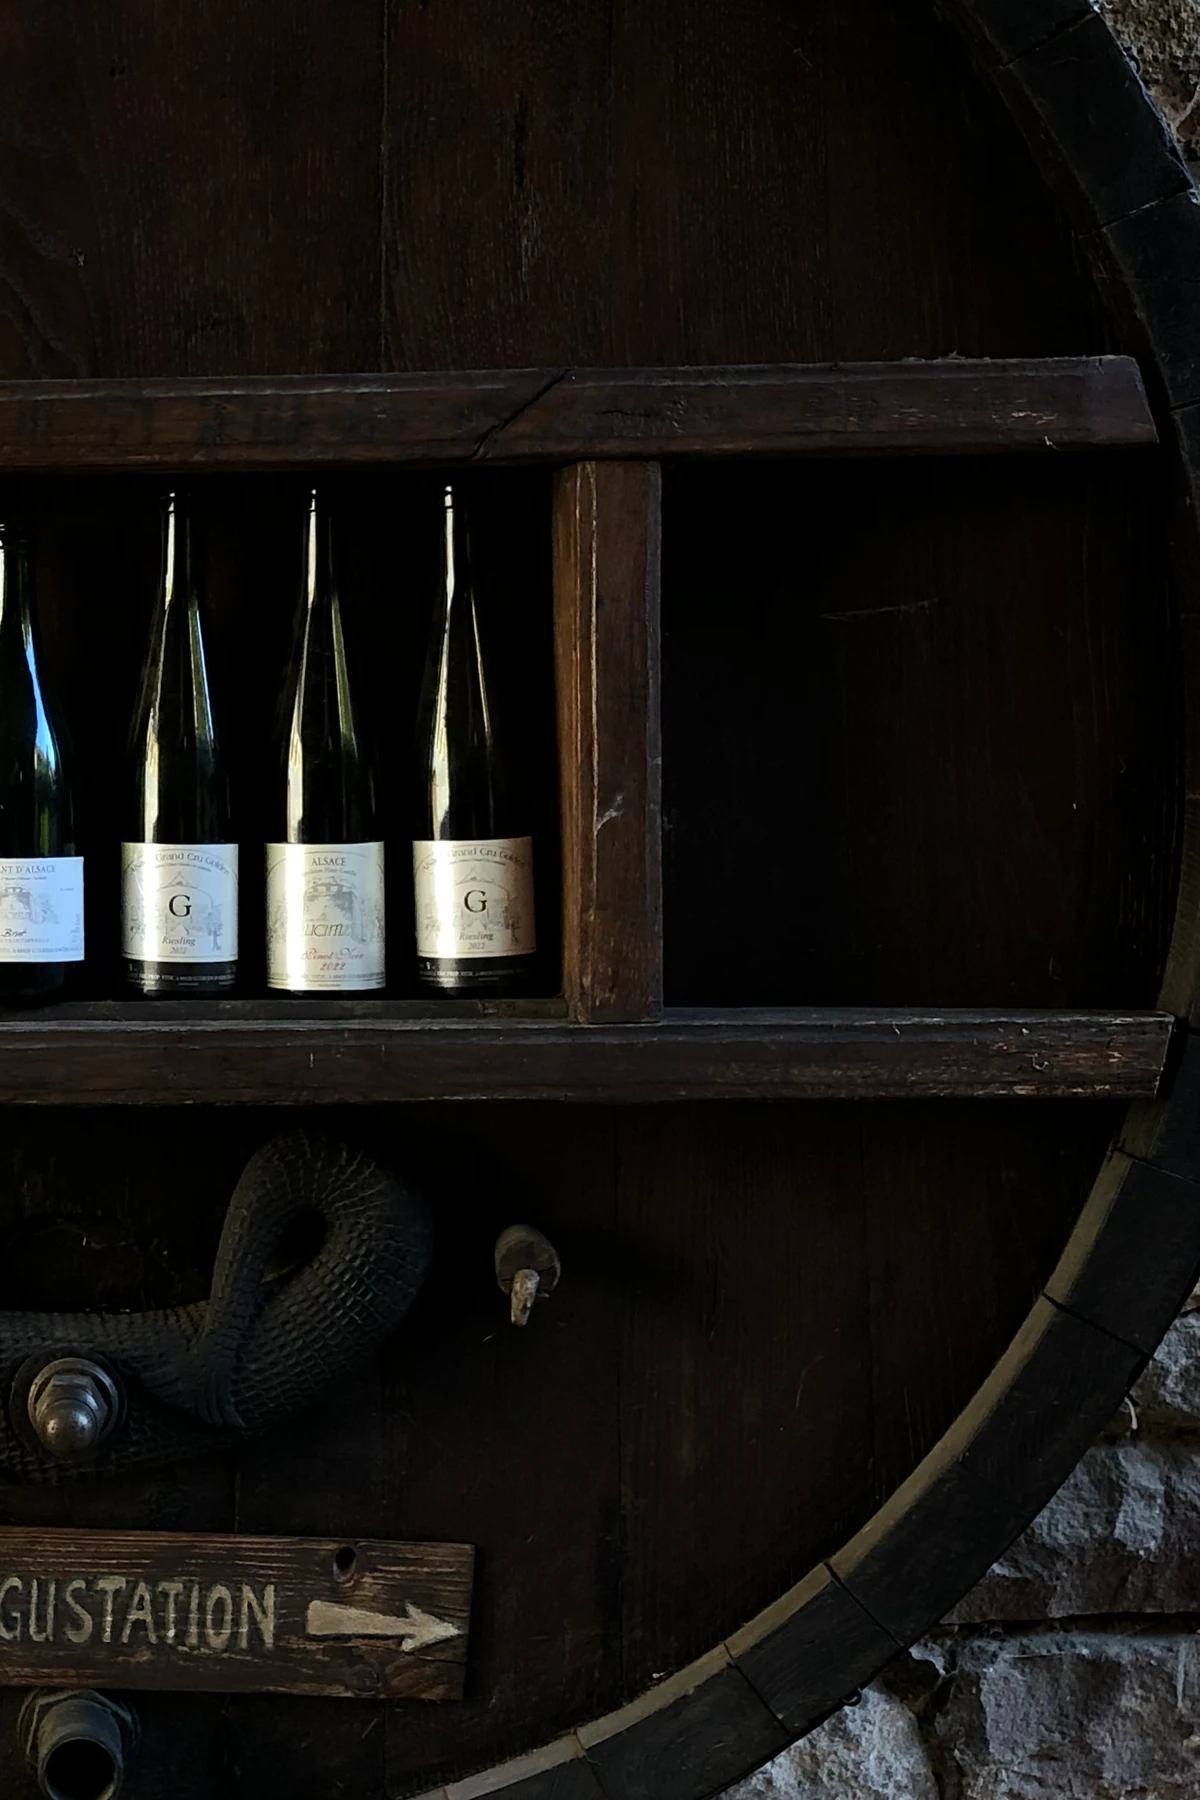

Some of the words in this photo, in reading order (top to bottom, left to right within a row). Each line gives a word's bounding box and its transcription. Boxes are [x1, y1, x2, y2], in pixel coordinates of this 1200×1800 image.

[187, 852, 203, 862] Cru
[311, 857, 346, 866] ALSACE
[168, 894, 192, 917] G
[464, 889, 487, 913] G
